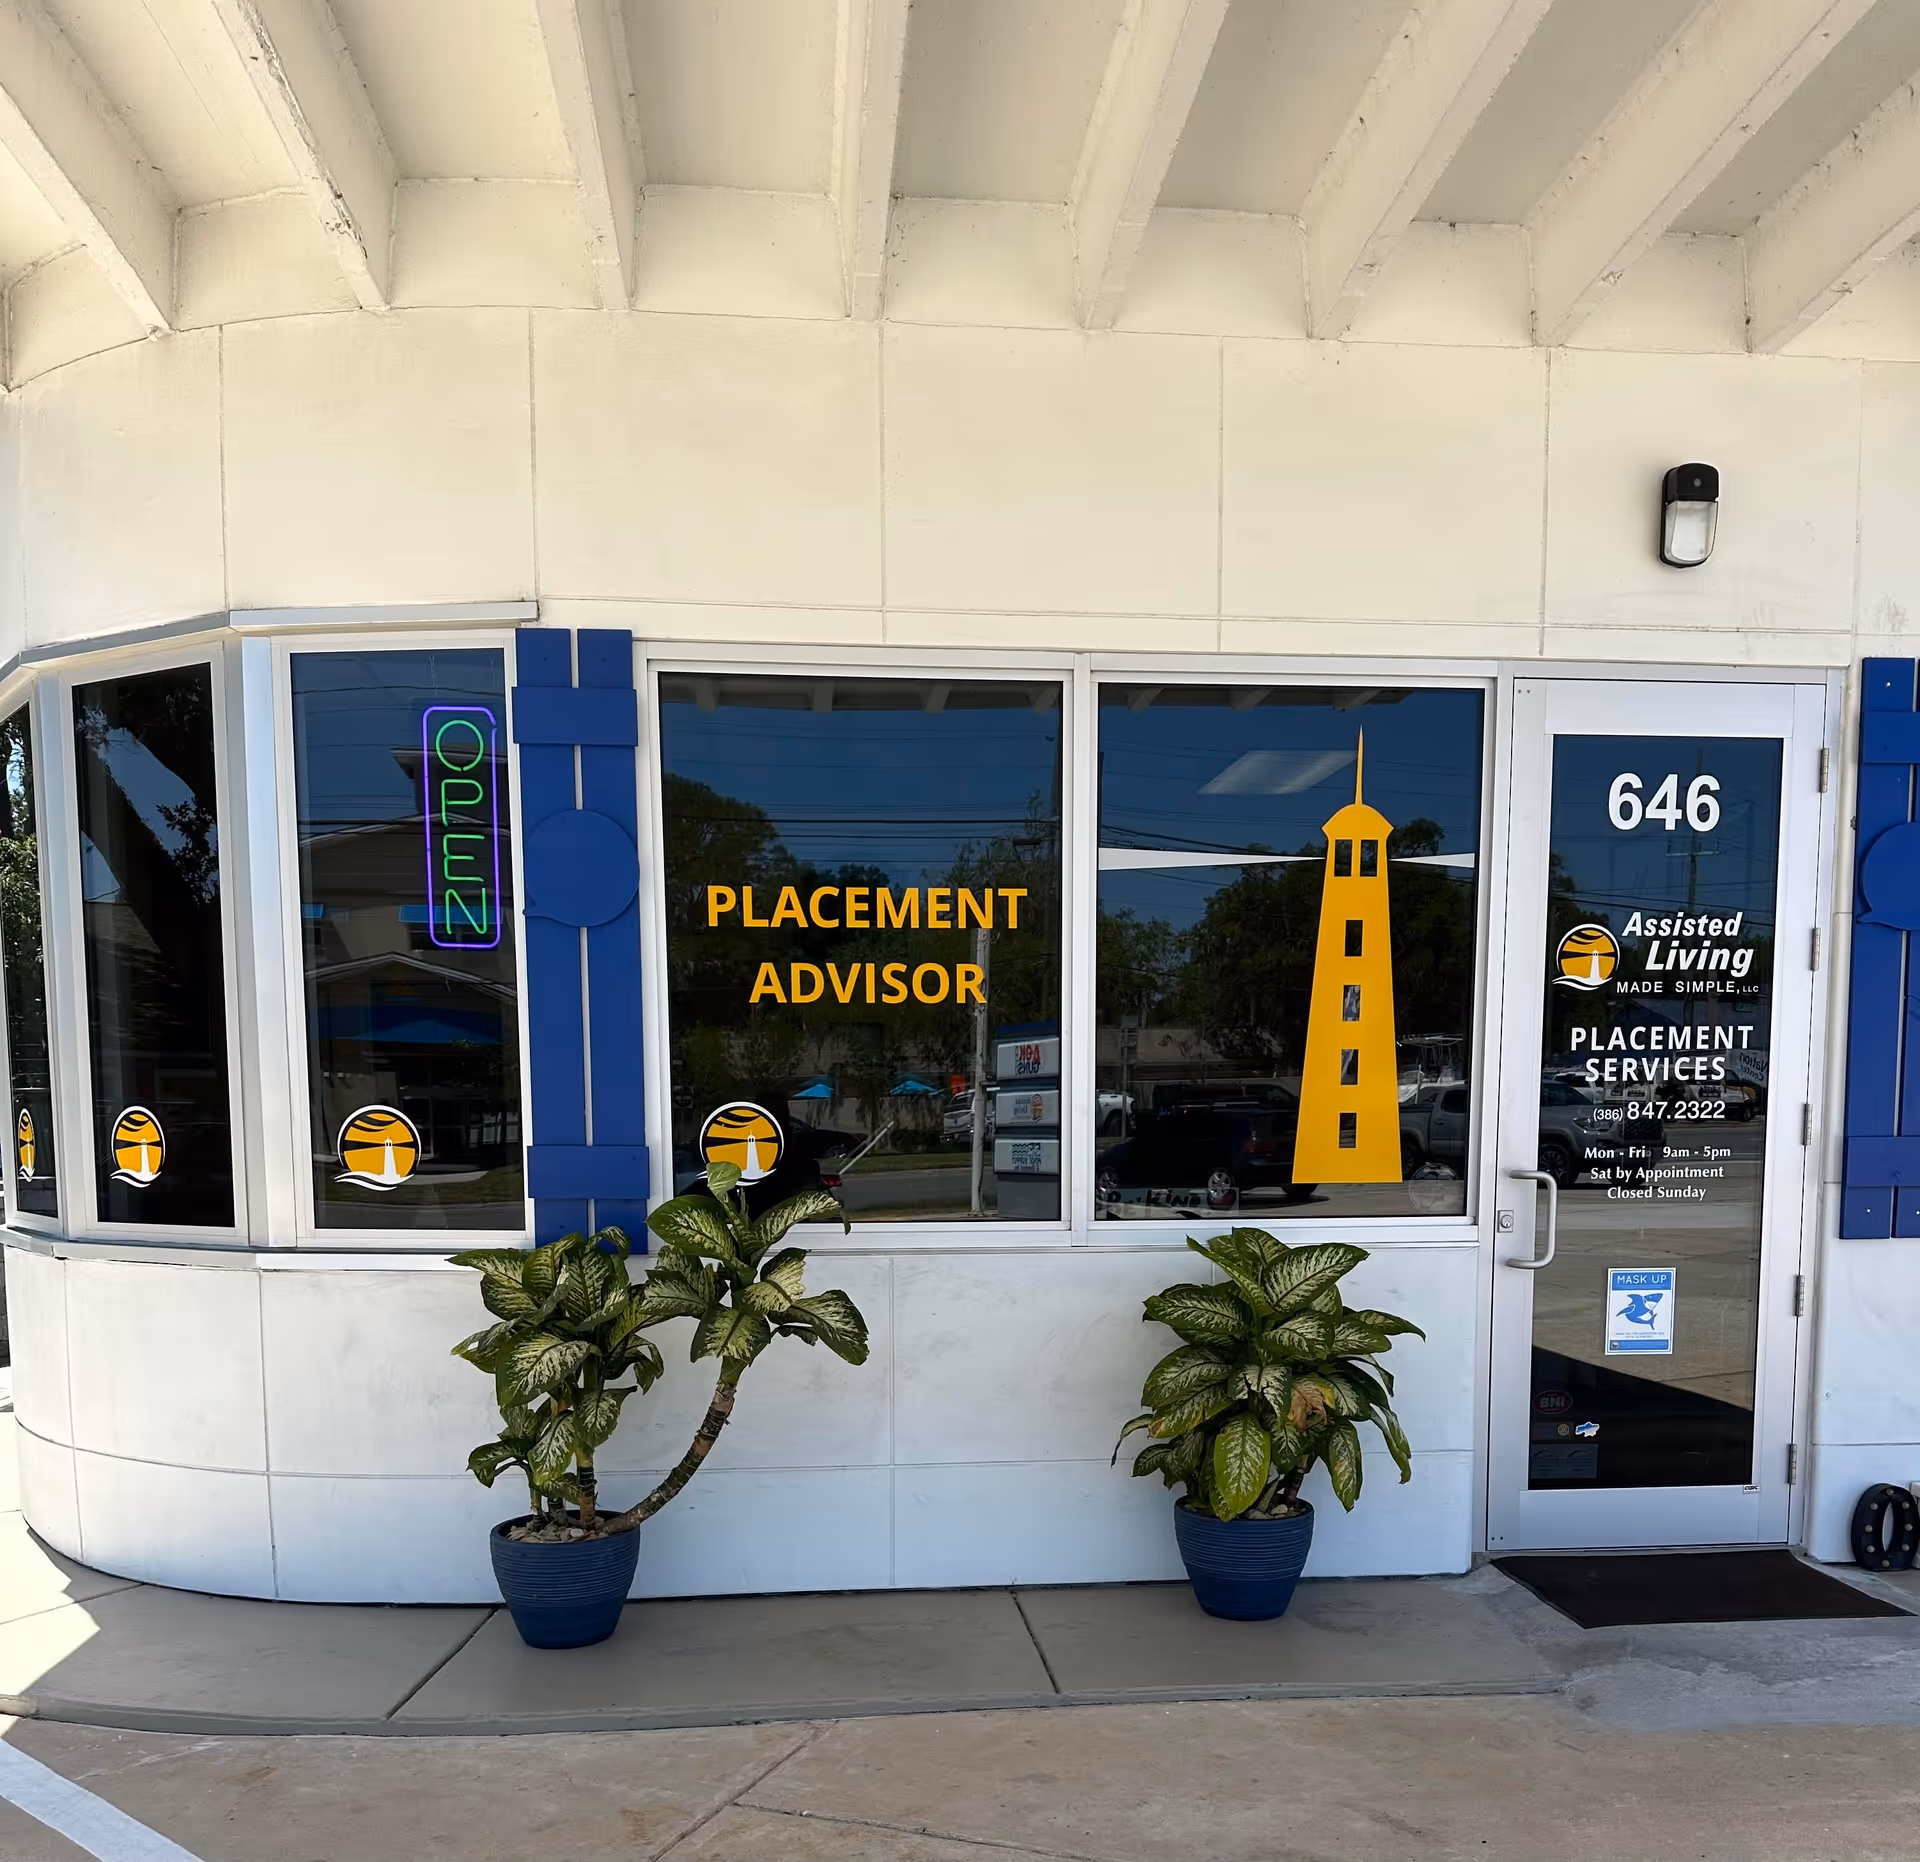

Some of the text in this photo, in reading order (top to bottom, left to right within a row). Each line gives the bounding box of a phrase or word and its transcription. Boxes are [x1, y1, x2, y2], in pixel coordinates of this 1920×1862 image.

[1608, 772, 1721, 832] 646
[435, 719, 488, 935] OPEN
[706, 885, 1028, 929] PLACEMENT
[1621, 911, 1744, 937] Assisted
[1644, 940, 1755, 977] Living
[748, 961, 988, 1004] ADVISOR
[1616, 981, 1664, 993] MADE
[1742, 985, 1759, 993] LLC
[1571, 1025, 1754, 1051] PLACEMENT
[1585, 1056, 1726, 1082] SERVICES
[1593, 1100, 1726, 1121] (386) 847.2322
[1584, 1147, 1615, 1159] Mon
[1628, 1145, 1646, 1158] Fri
[1662, 1146, 1690, 1158] 9am
[1703, 1146, 1731, 1160] 5pm
[1590, 1166, 1724, 1182] Sat by Appointment
[1607, 1185, 1707, 1201] Closed Sunday
[1617, 1273, 1667, 1285] MASK UP
[1540, 1396, 1566, 1409] BNI
